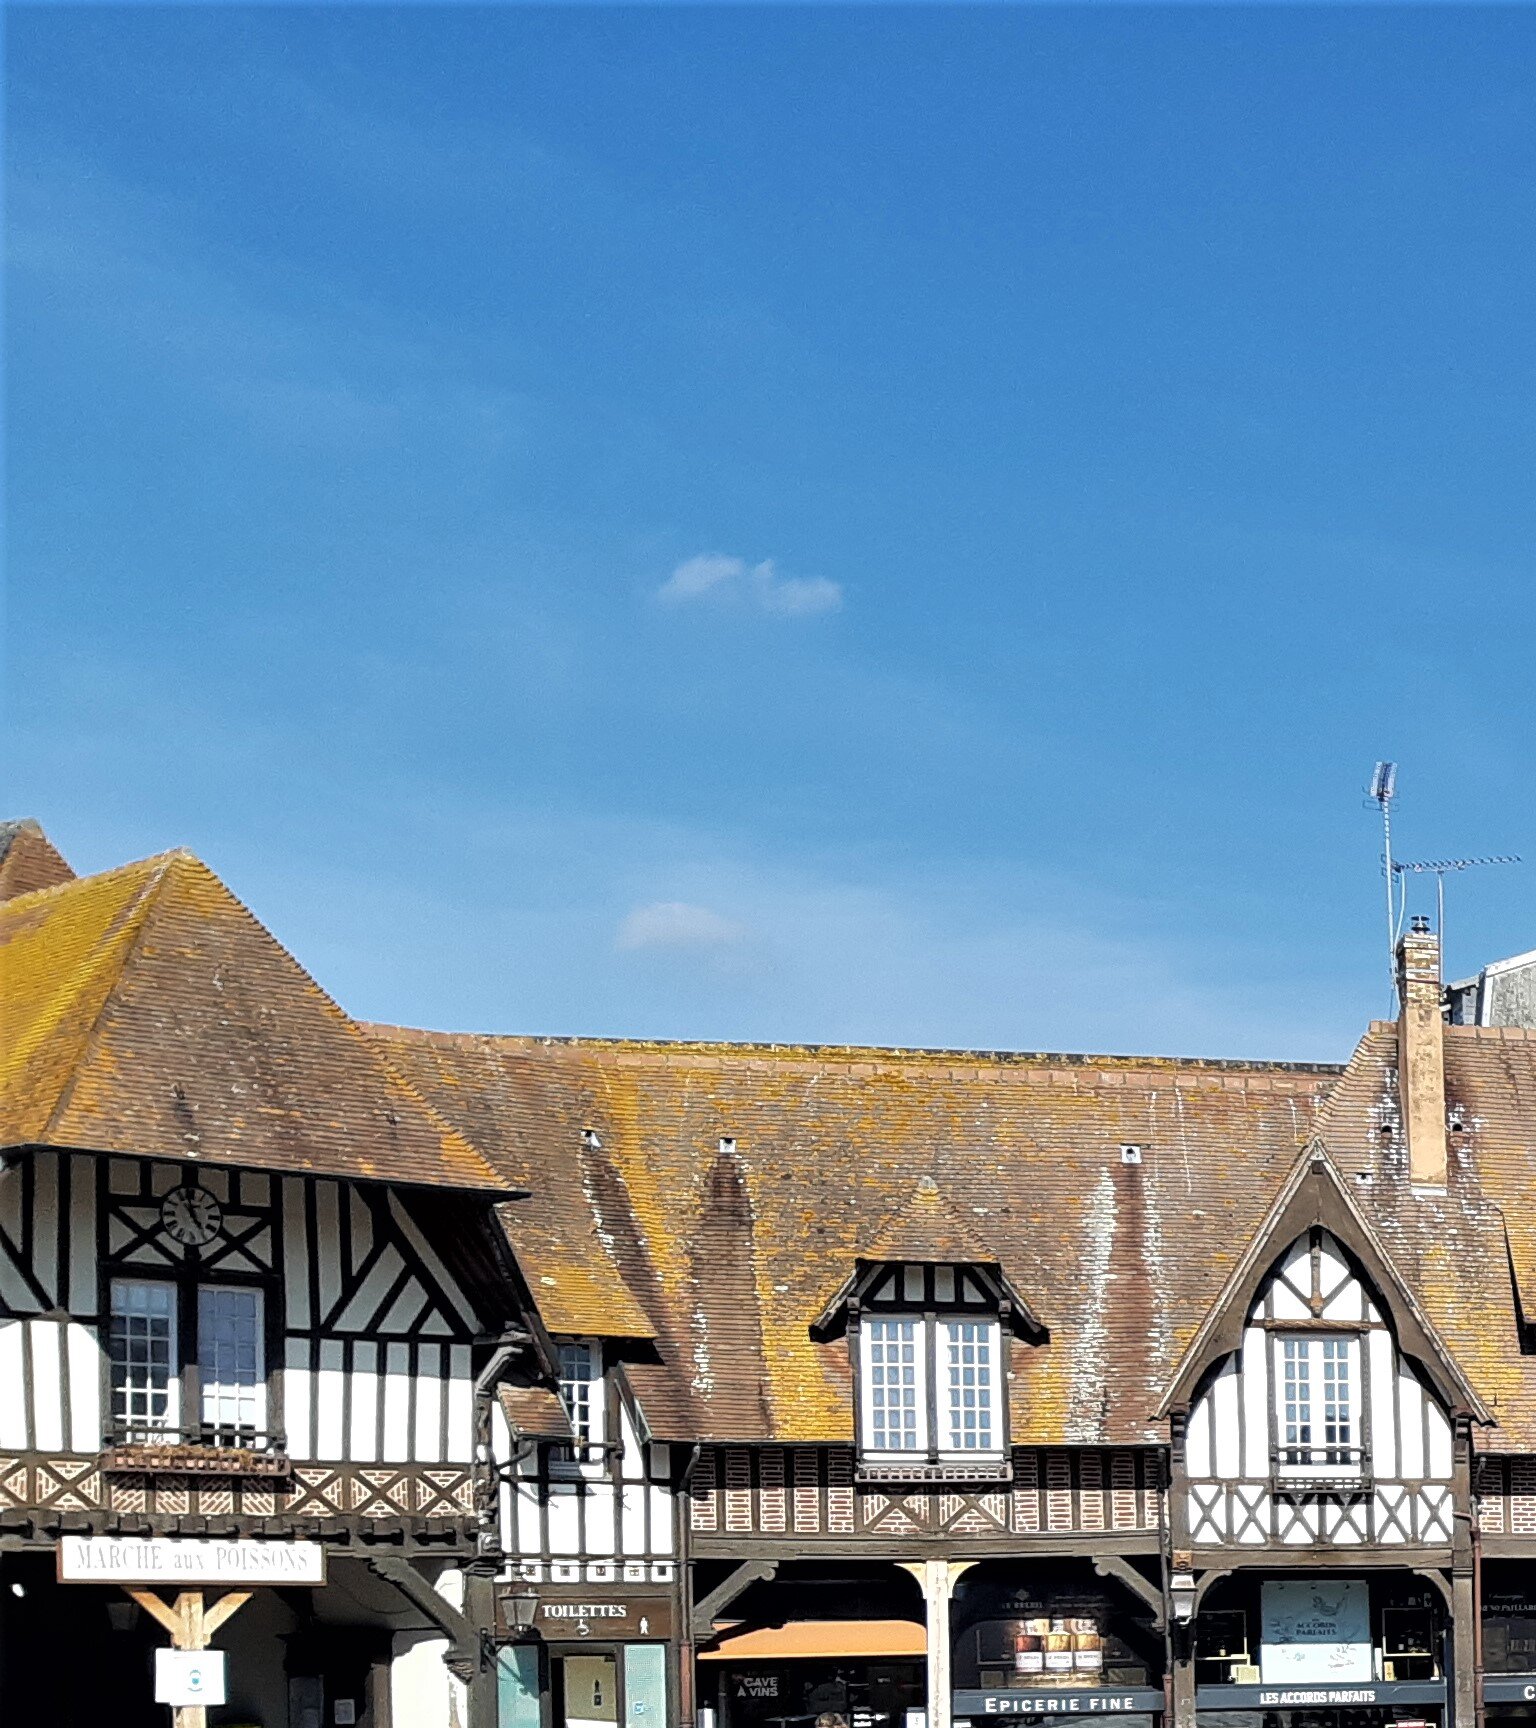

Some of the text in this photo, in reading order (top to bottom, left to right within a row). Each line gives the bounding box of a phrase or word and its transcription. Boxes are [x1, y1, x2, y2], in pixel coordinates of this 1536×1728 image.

[174, 1553, 204, 1569] aux
[216, 1546, 307, 1571] POISSONS
[541, 1604, 627, 1617] TOILETTES
[743, 1677, 779, 1687] CAVE
[749, 1687, 778, 1697] VINS
[1260, 1690, 1376, 1704] LES ACCORDS PARFAITS
[985, 1697, 1134, 1713] EPICERIE FINE
